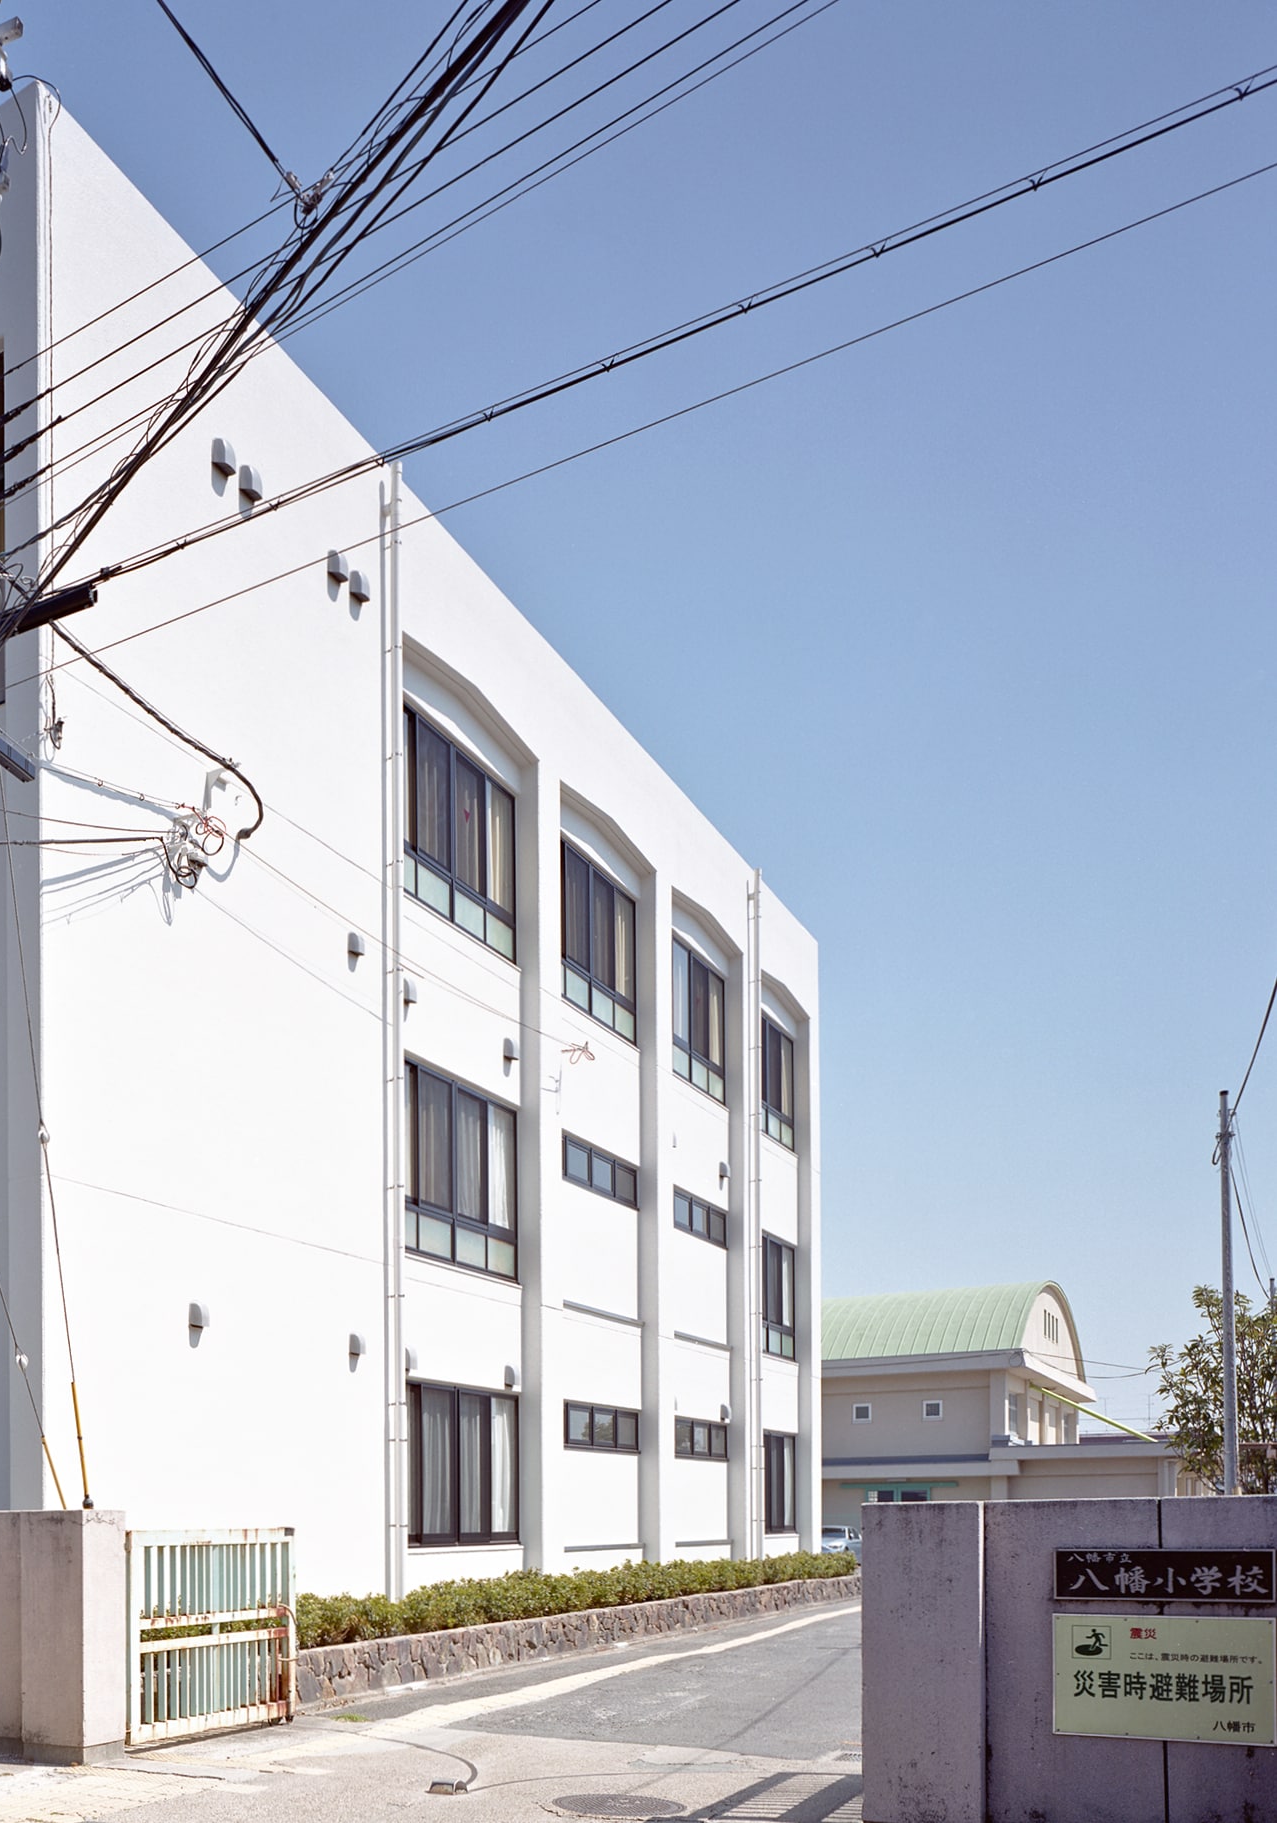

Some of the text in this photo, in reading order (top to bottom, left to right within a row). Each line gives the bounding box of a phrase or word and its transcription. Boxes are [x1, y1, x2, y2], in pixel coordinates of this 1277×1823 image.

[1067, 1552, 1133, 1564] 八幡市立
[1069, 1565, 1268, 1596] 八幡小学校
[1129, 1627, 1158, 1640] 震災
[1073, 1670, 1254, 1705] 災害時避難場所
[1212, 1720, 1256, 1734] 八幡市
